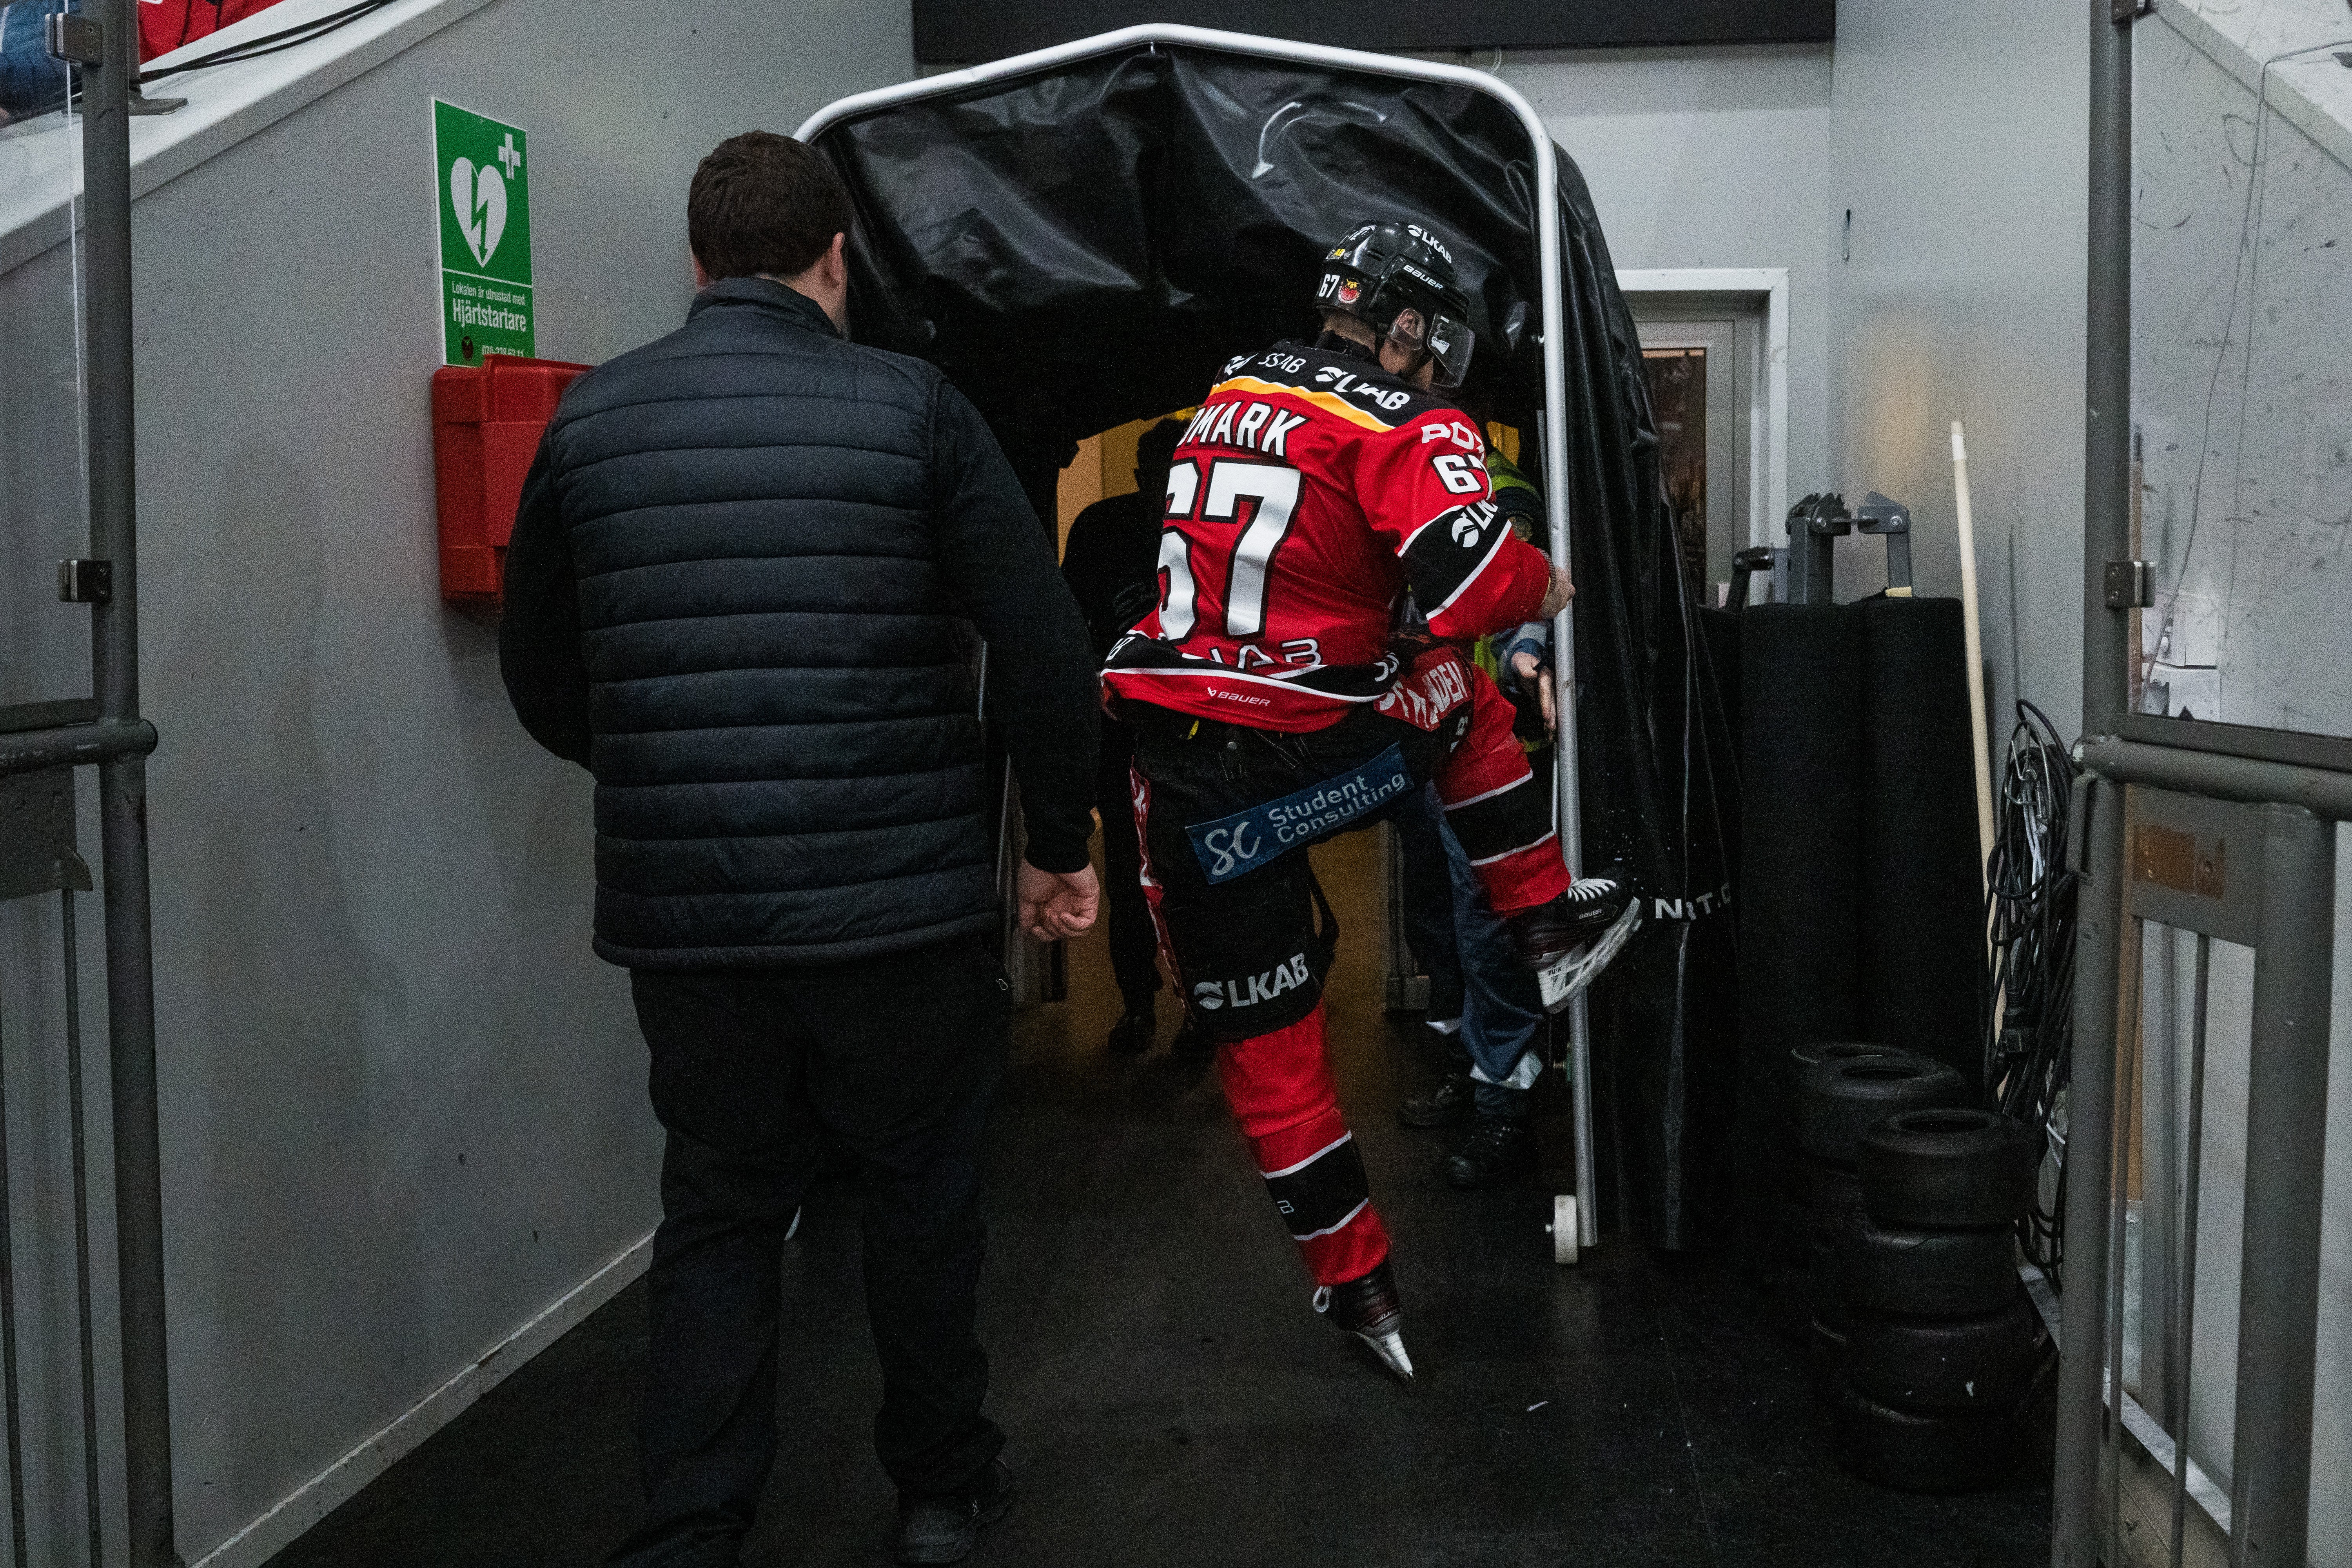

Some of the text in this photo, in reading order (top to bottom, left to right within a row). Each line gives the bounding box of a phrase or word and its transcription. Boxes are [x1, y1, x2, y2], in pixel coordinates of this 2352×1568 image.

[1422, 231, 1452, 263] LKAB
[452, 281, 525, 305] Lokalen är utrustad med
[1319, 274, 1340, 298] 67
[1403, 265, 1443, 290] BAUER
[453, 298, 526, 332] Hjärtstartare
[1258, 353, 1307, 373] SSAB
[1218, 691, 1271, 706] BAUER
[1268, 775, 1368, 828] Student
[1277, 773, 1406, 843] Consulting
[1204, 821, 1261, 876] SC
[1228, 953, 1308, 1007] LKAB
